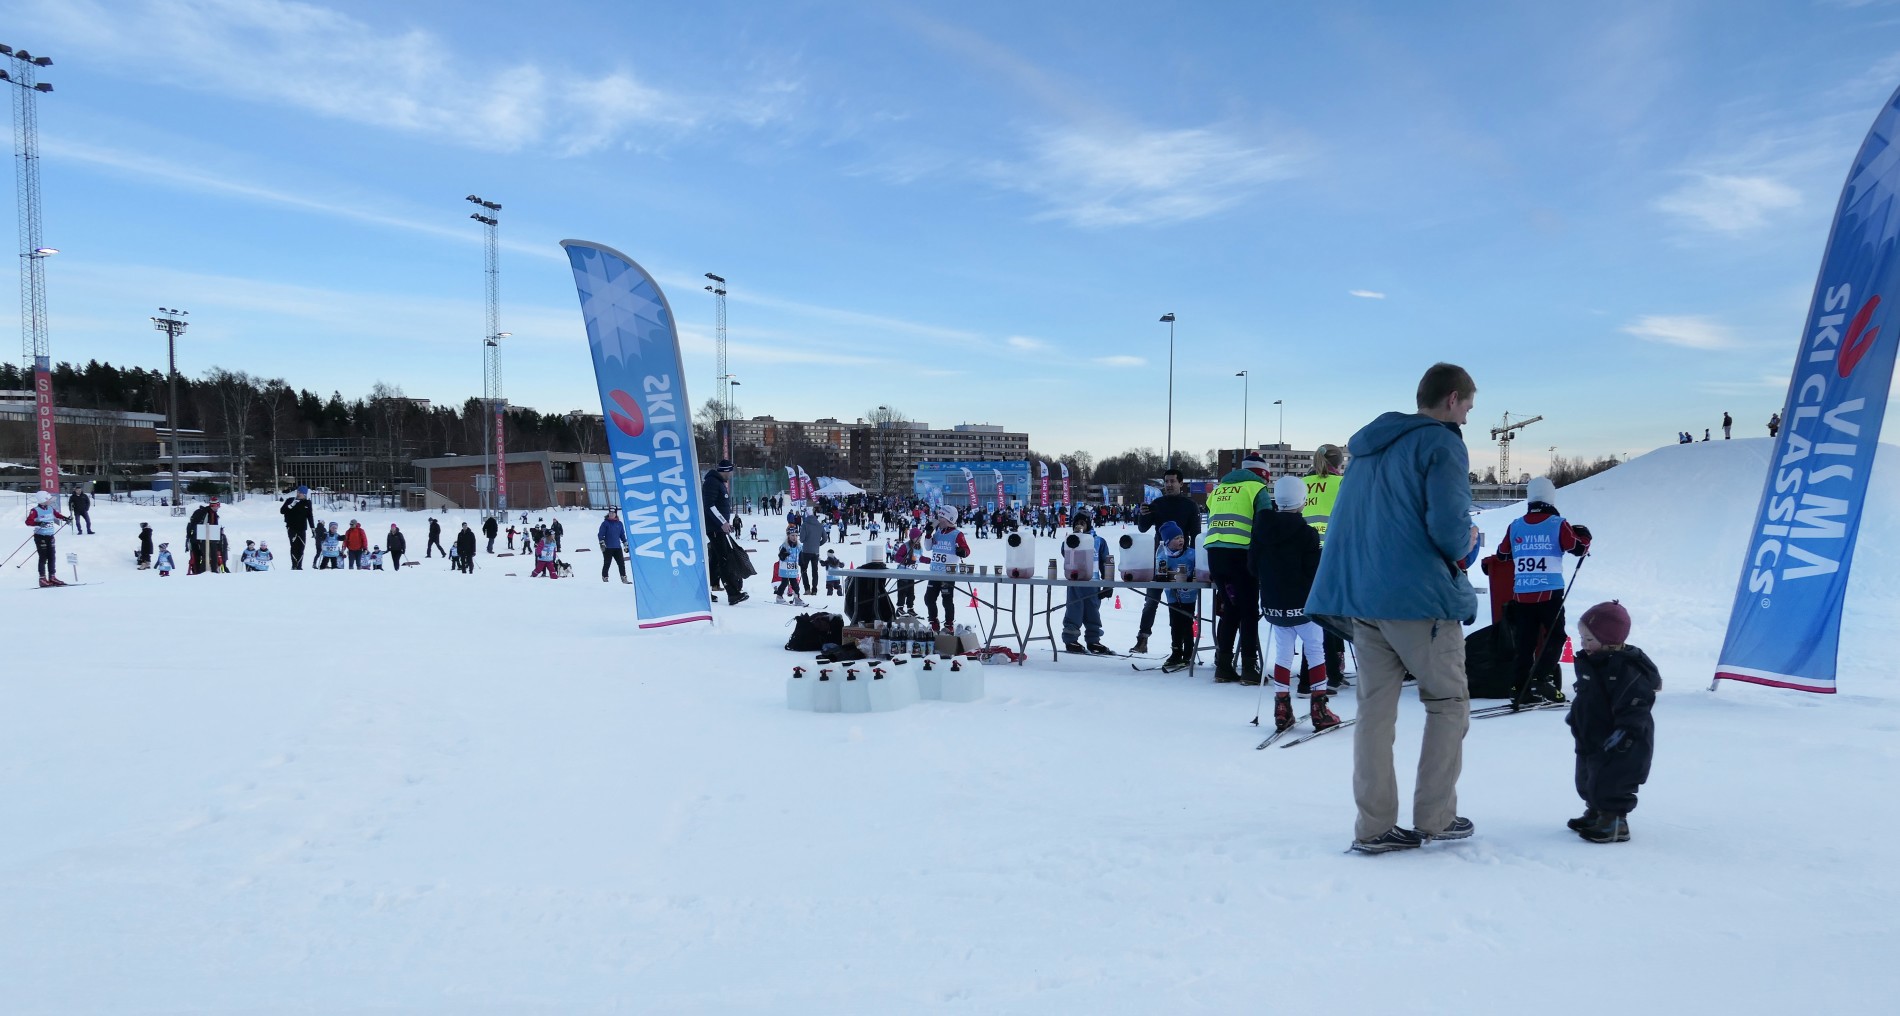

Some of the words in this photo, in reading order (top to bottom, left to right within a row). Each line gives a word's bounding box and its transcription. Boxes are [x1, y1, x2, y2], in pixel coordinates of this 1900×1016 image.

[1810, 280, 1851, 363] SKI
[38, 378, 54, 489] Snøparken
[1306, 482, 1327, 494] YN
[1748, 372, 1825, 597] CLASSICS
[1782, 395, 1866, 582] VISMA
[1213, 486, 1243, 496] LYN
[1524, 534, 1551, 543] VISMA
[1521, 543, 1553, 551] CLASSICS
[931, 553, 947, 563] 556
[1517, 557, 1547, 572] 594
[1523, 577, 1549, 587] KIDS
[1262, 606, 1283, 617] LYN
[1286, 607, 1305, 618] SK
